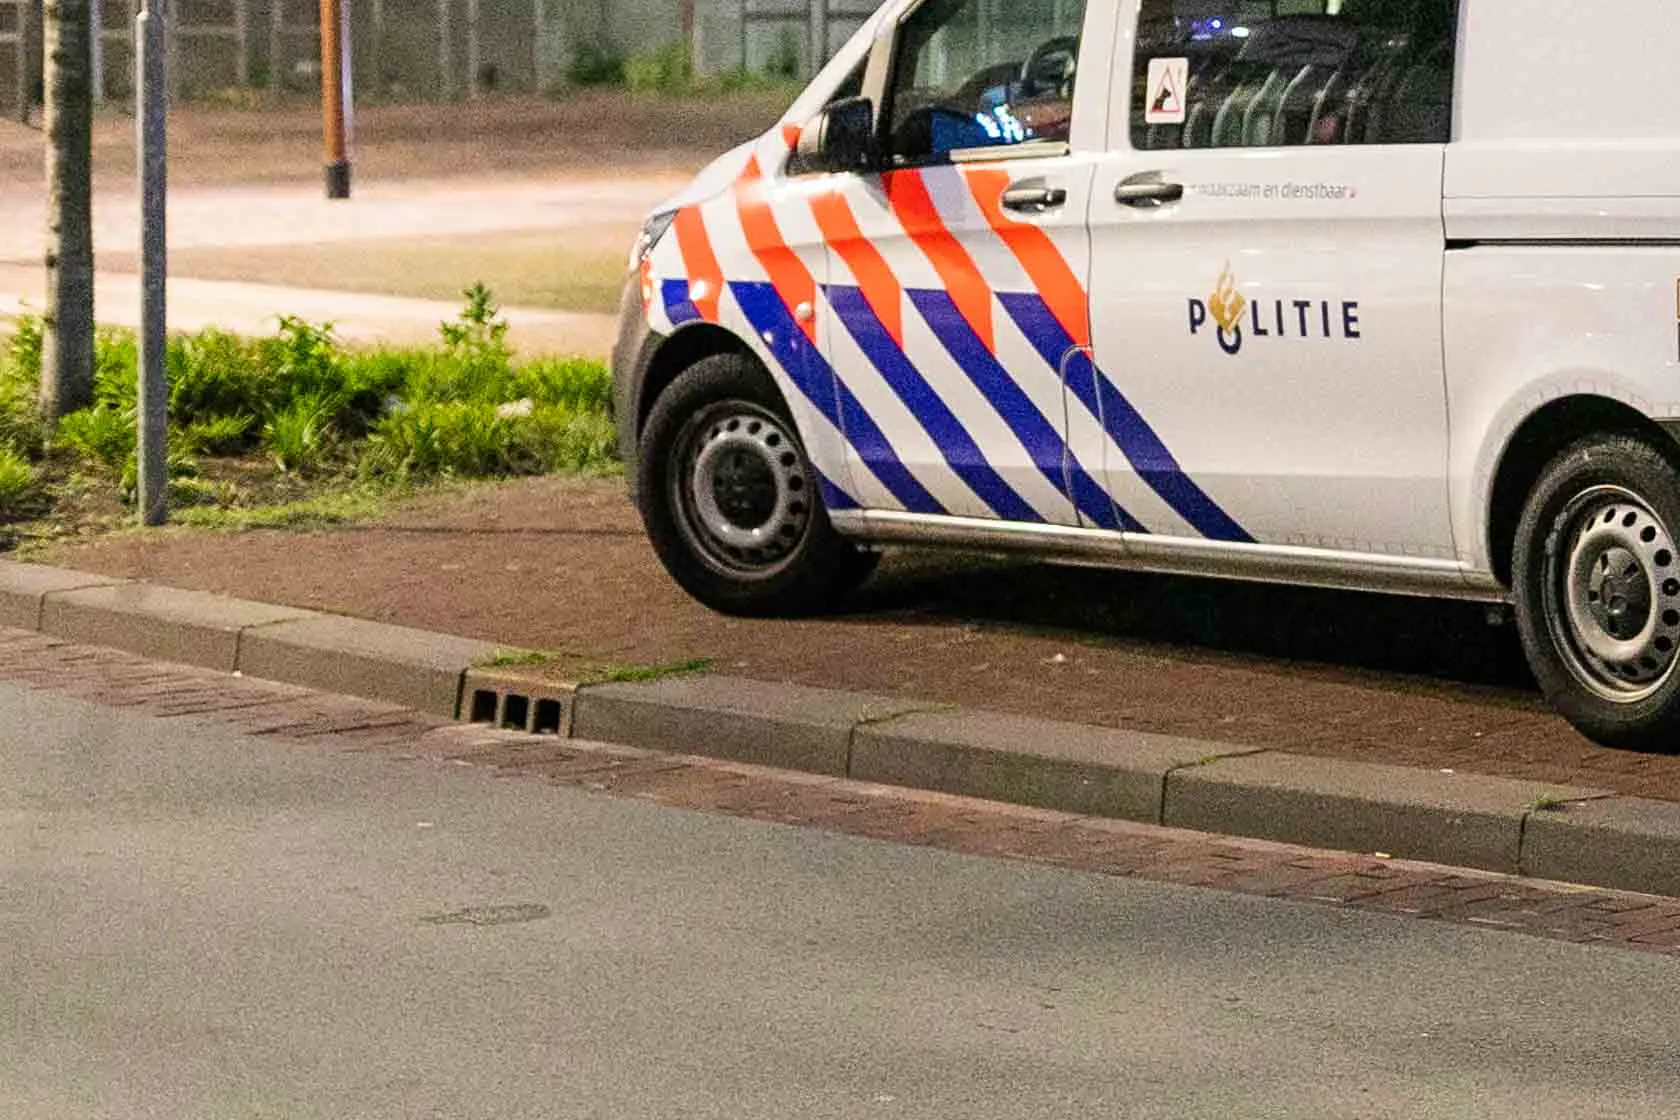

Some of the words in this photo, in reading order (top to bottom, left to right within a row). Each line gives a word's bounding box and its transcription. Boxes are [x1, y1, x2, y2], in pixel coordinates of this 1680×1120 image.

[1263, 183, 1279, 199] en
[1281, 181, 1347, 199] dienstbaar
[1188, 298, 1361, 355] POLITIE
